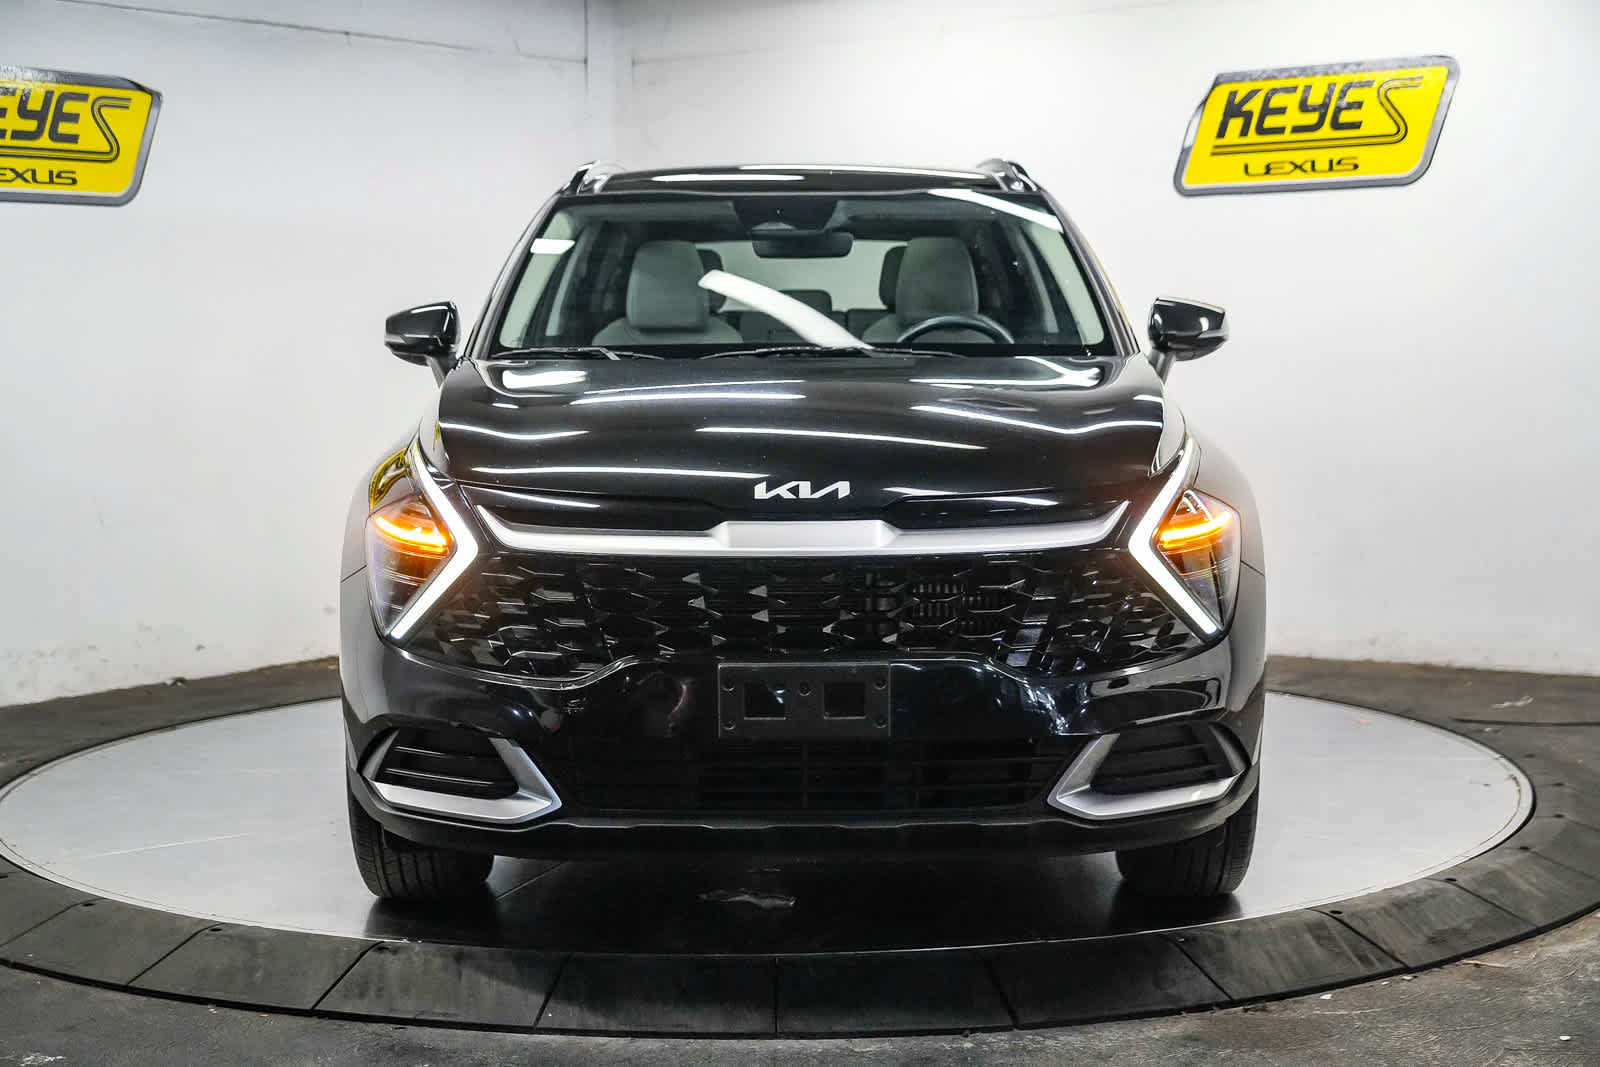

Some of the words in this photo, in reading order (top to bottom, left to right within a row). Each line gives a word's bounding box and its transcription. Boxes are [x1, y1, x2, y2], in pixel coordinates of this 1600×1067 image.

[1212, 76, 1424, 154] KEYES
[1244, 156, 1359, 177] LEXUS
[754, 480, 850, 499] KIA
